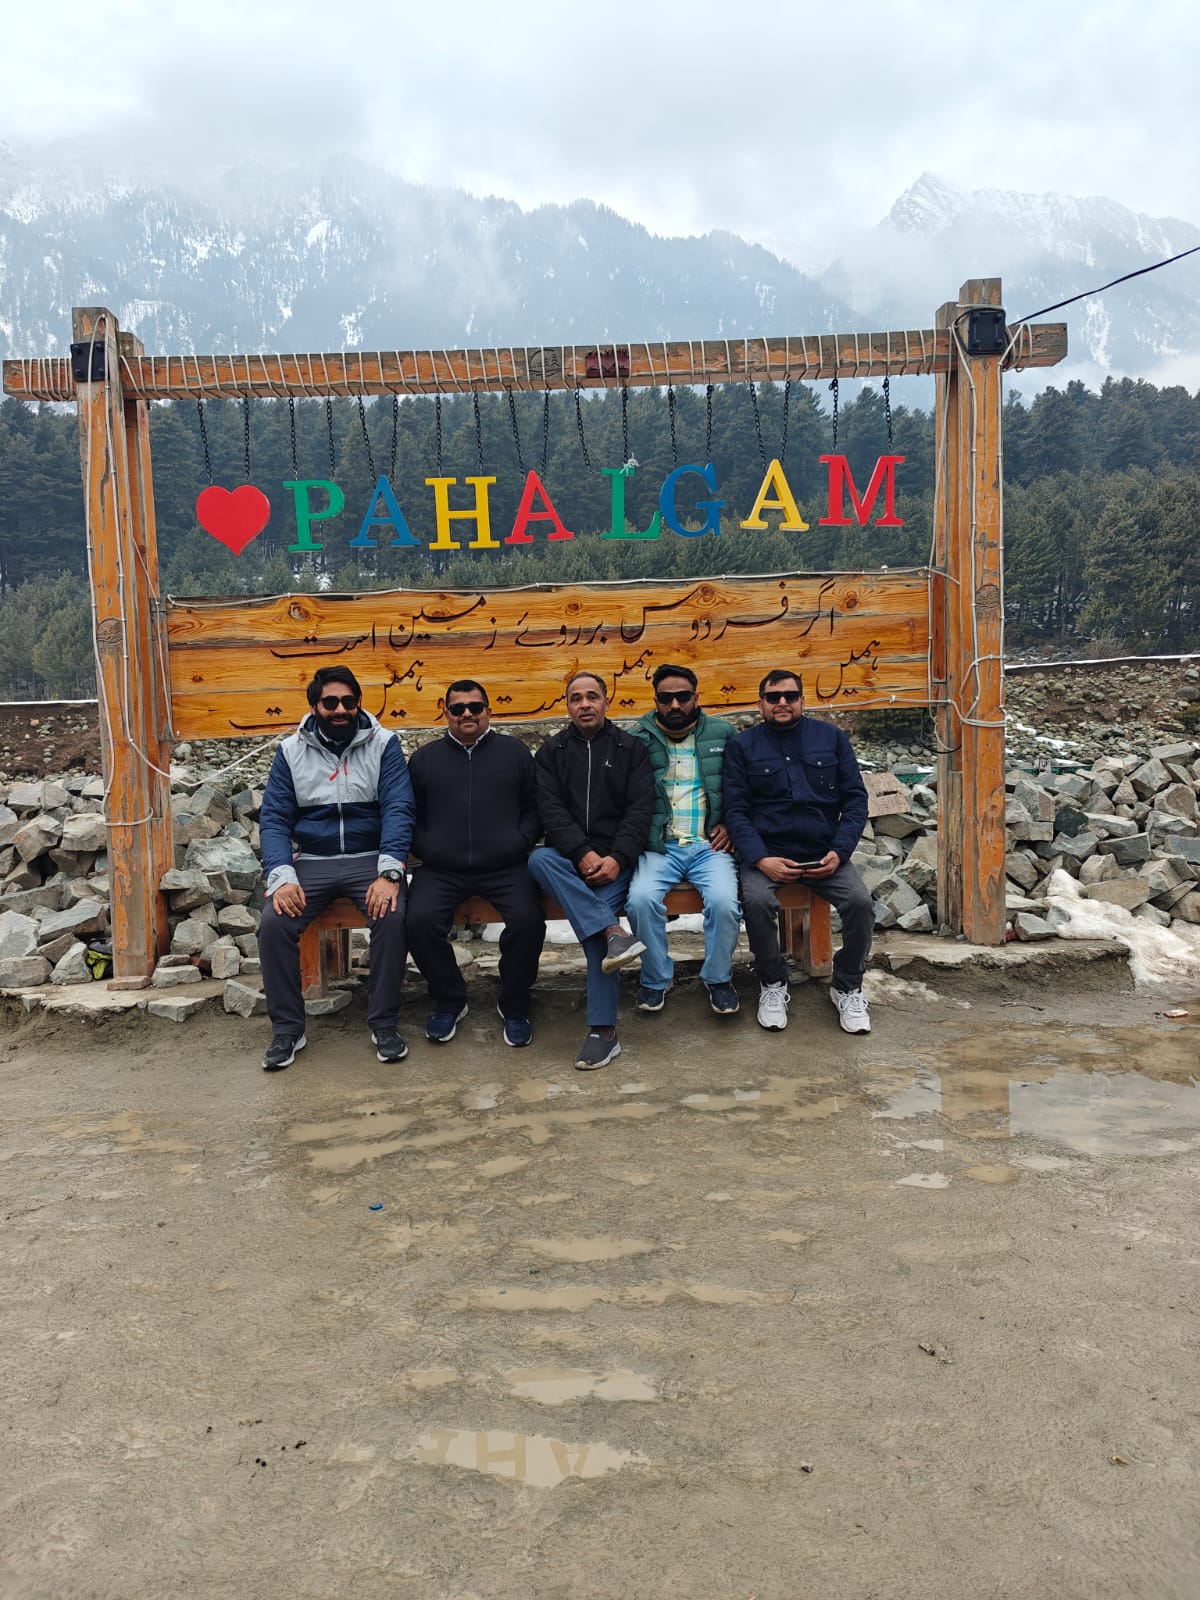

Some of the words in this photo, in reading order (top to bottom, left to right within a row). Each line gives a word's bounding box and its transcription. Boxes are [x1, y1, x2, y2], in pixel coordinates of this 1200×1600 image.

[282, 455, 905, 551] PAHALGAM
[621, 581, 789, 643] فردوس
[795, 578, 837, 638] اگر
[269, 621, 376, 658] است
